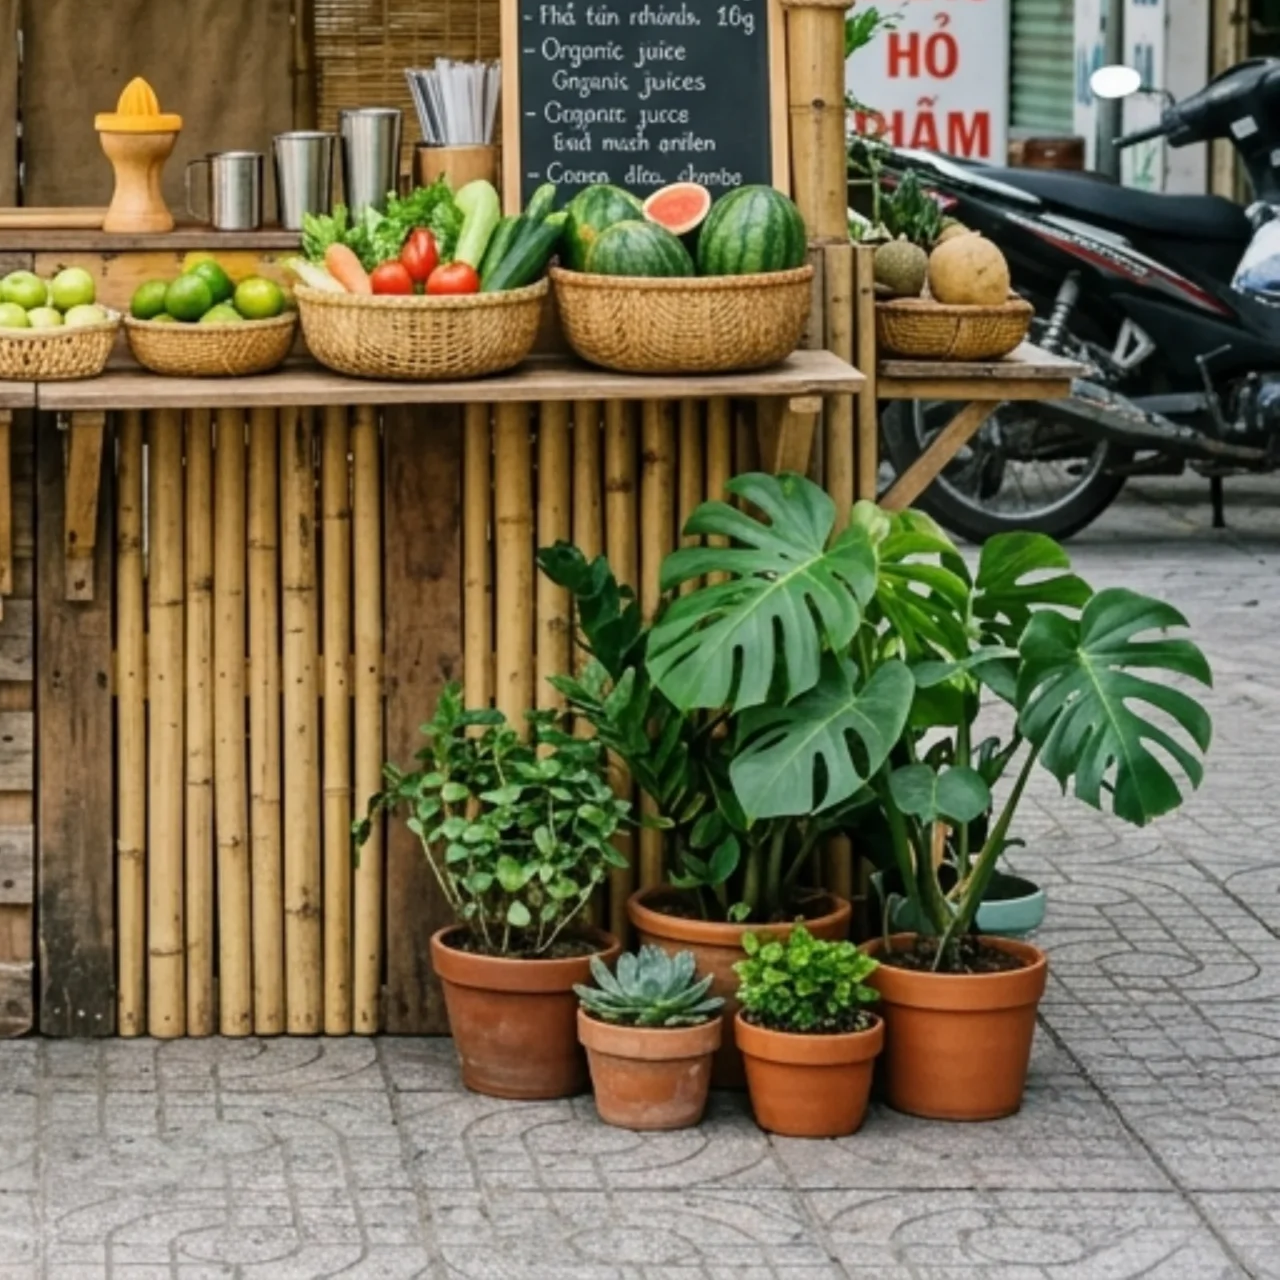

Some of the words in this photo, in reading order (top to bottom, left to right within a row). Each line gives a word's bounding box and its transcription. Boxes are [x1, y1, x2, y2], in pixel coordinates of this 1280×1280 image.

[541, 36, 624, 68] Organic
[633, 41, 687, 68] juice
[886, 14, 960, 79] HỎ
[637, 71, 706, 100] juices
